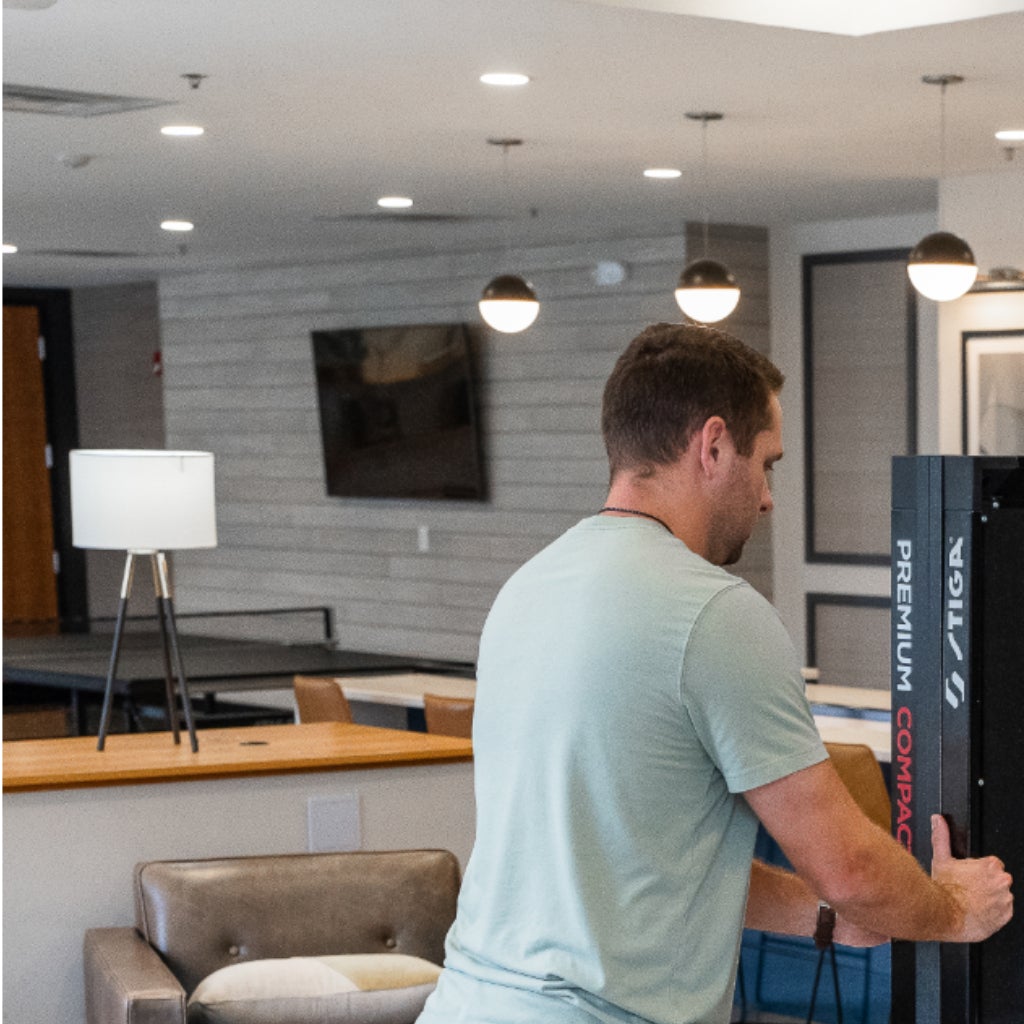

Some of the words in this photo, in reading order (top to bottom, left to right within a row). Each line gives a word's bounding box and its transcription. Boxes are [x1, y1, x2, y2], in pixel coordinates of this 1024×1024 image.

[897, 540, 912, 691] PREMIUM
[948, 537, 963, 661] STIGA
[897, 707, 912, 856] COMPAC
